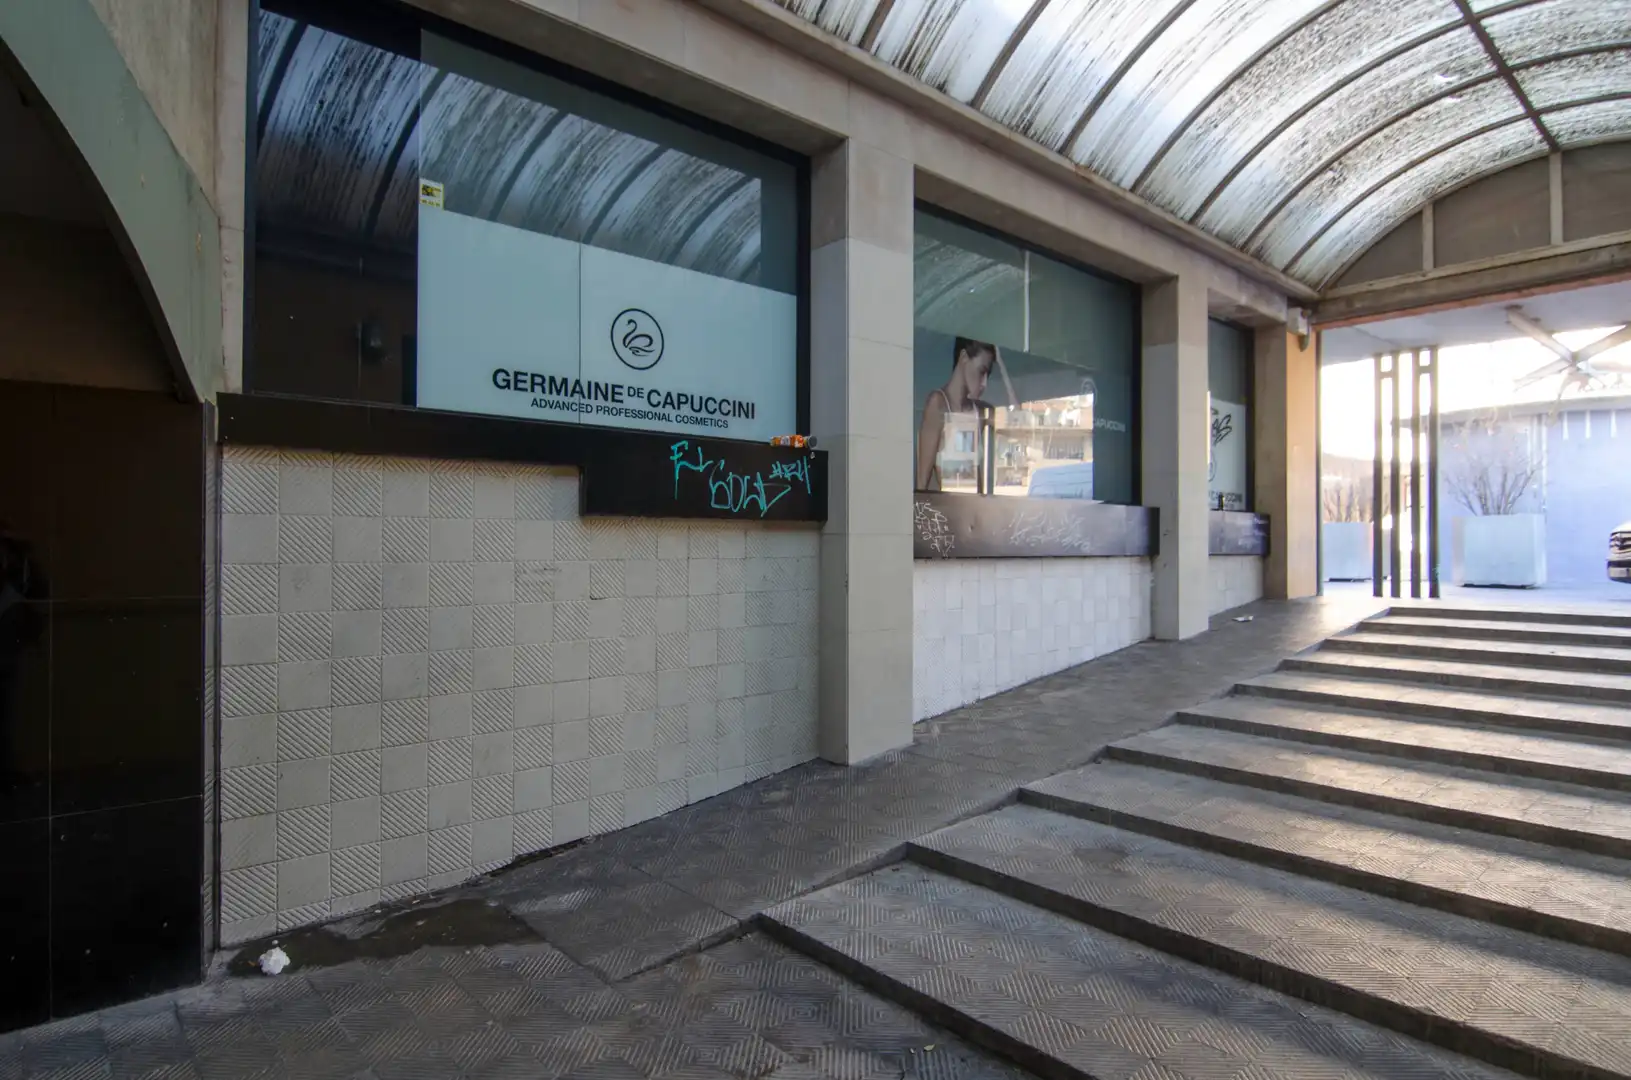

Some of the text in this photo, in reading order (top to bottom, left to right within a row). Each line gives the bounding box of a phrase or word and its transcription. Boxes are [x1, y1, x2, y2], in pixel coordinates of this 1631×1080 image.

[492, 368, 756, 420] GERMAINE DE CAPUCCINI
[530, 397, 729, 429] ADVANCED PROFESSIONAL COSMETICS
